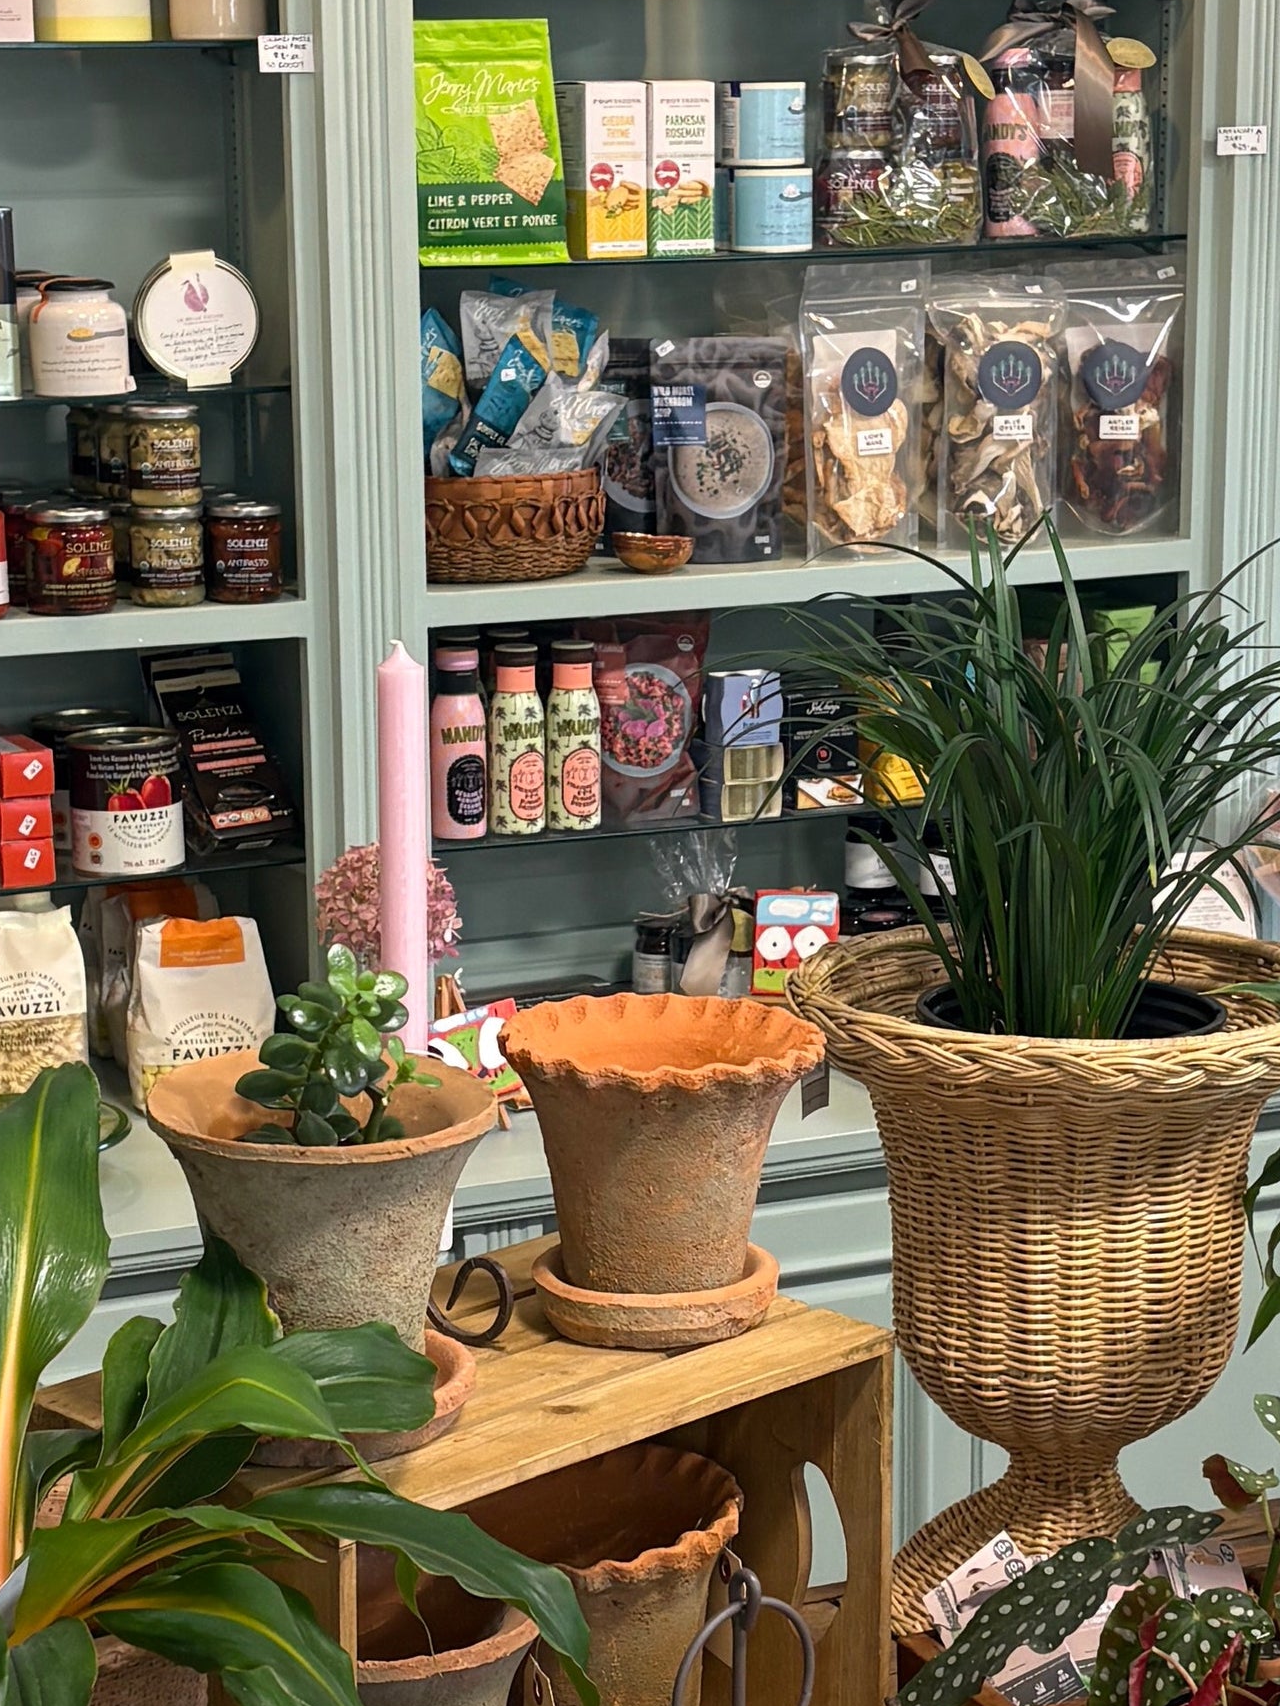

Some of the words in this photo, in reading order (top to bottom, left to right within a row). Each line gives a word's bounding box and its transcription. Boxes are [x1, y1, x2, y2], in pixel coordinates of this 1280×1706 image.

[665, 115, 706, 126] PARMESAN
[665, 127, 706, 139] ROSEMARY
[428, 195, 455, 208] LIME
[457, 195, 467, 207] &
[471, 193, 513, 206] PEPPER
[428, 217, 469, 230] CITRON
[472, 216, 500, 228] VERT
[504, 216, 519, 227] ET
[522, 214, 558, 227] POIVRE
[176, 704, 243, 722] SOLENZI
[113, 809, 168, 824] FAVUZZI
[17, 971, 28, 980] DE
[171, 1012, 205, 1035] MEILLEUR
[208, 1012, 219, 1020] DE
